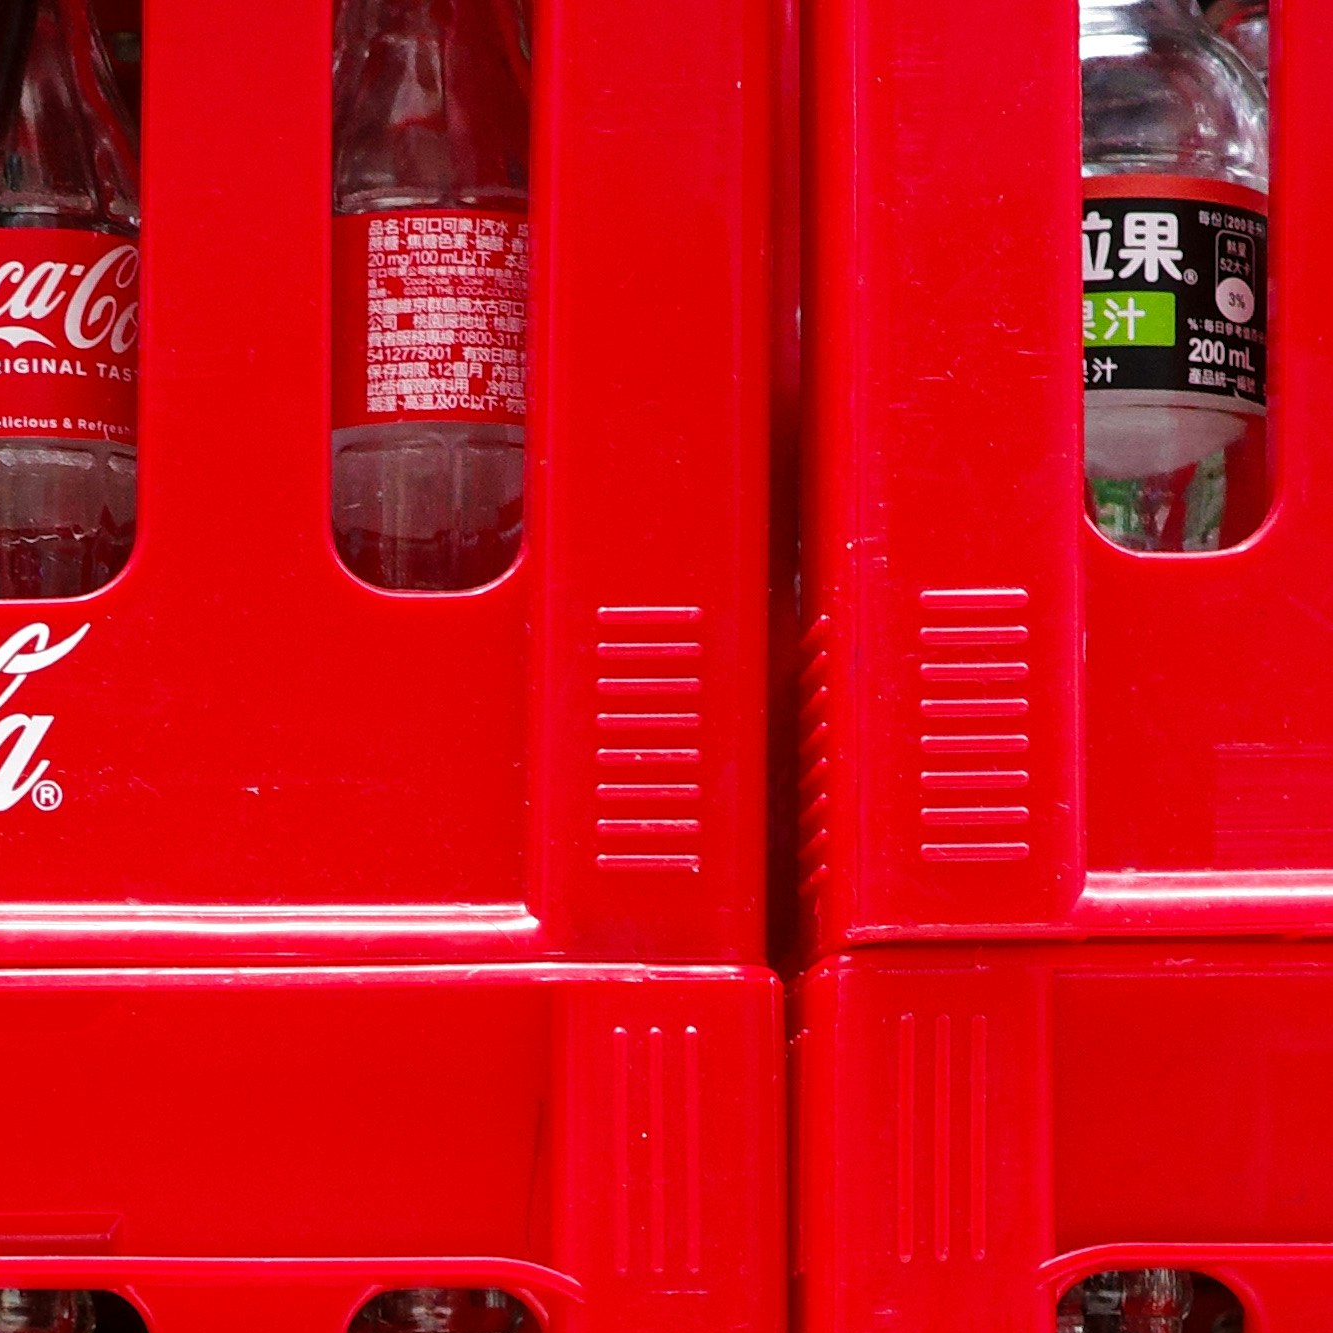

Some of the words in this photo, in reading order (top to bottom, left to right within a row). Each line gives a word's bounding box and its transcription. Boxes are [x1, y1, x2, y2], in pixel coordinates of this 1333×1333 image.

[1188, 338, 1225, 365] 200
[1230, 347, 1256, 372] mL
[63, 418, 73, 429] &
